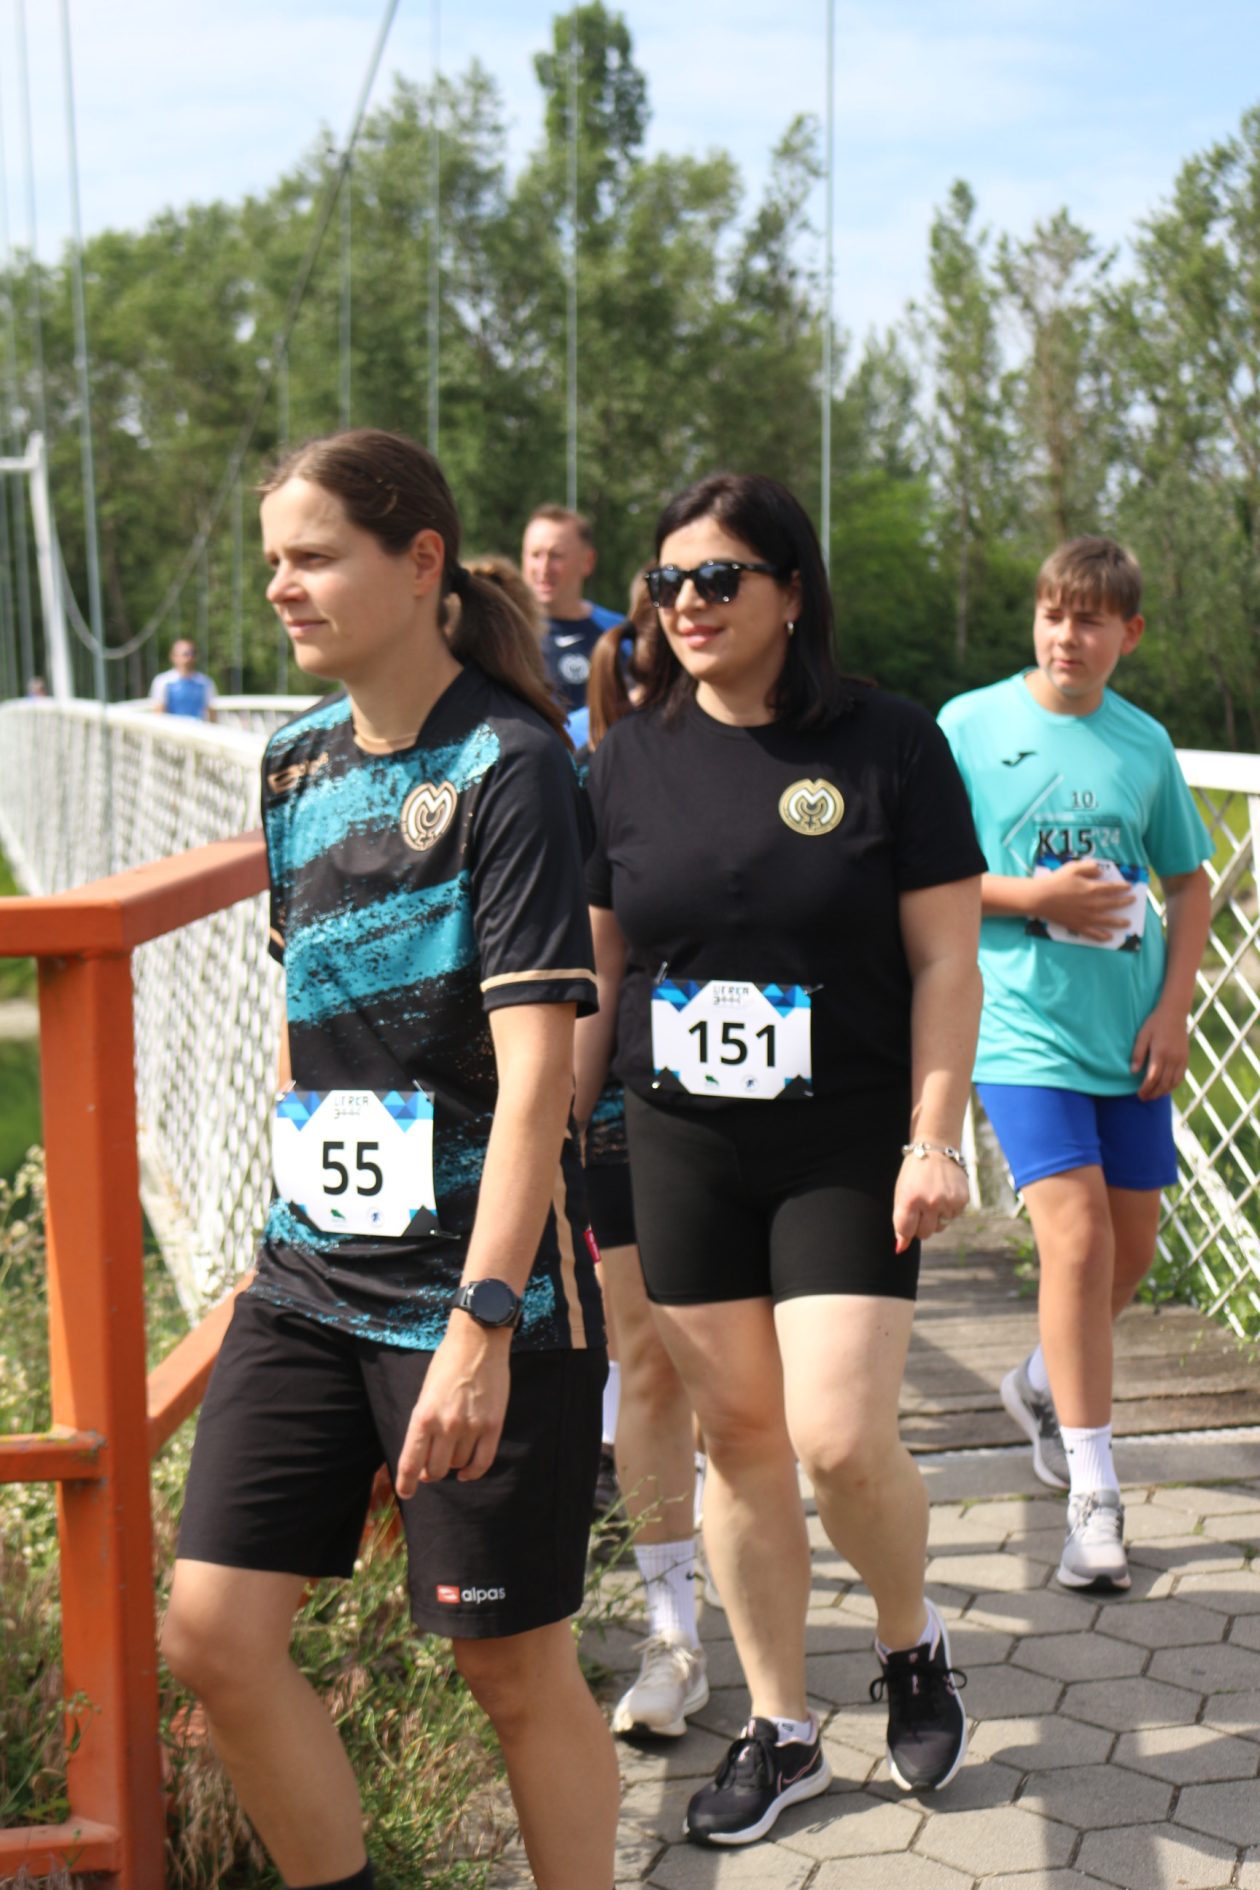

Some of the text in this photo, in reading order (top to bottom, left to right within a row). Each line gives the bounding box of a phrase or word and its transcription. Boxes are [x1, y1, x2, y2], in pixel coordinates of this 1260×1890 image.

[688, 1020, 775, 1068] 151
[322, 1140, 384, 1197] 55
[461, 1586, 506, 1605] alpas
